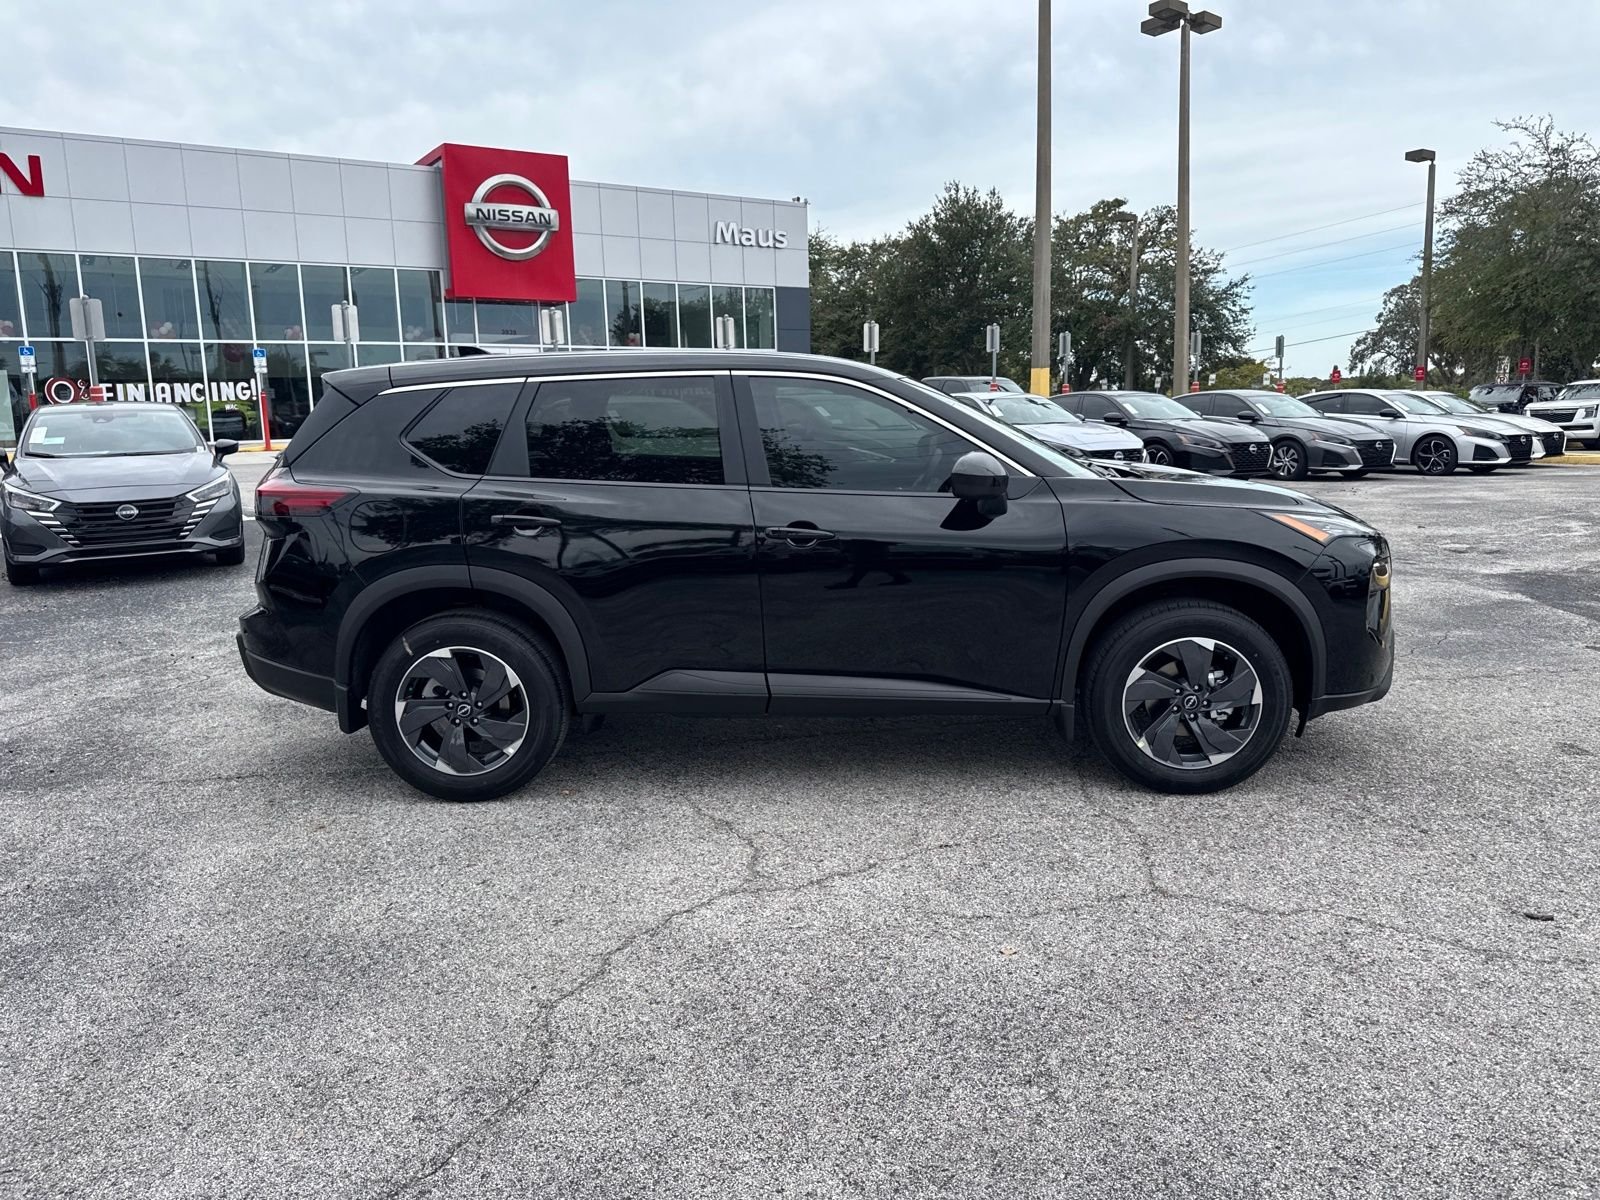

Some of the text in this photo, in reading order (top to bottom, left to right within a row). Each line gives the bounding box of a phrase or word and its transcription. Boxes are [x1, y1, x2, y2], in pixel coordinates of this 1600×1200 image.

[475, 207, 552, 225] NISSAN
[714, 221, 788, 249] Maus
[99, 378, 258, 403] FINANCING!
